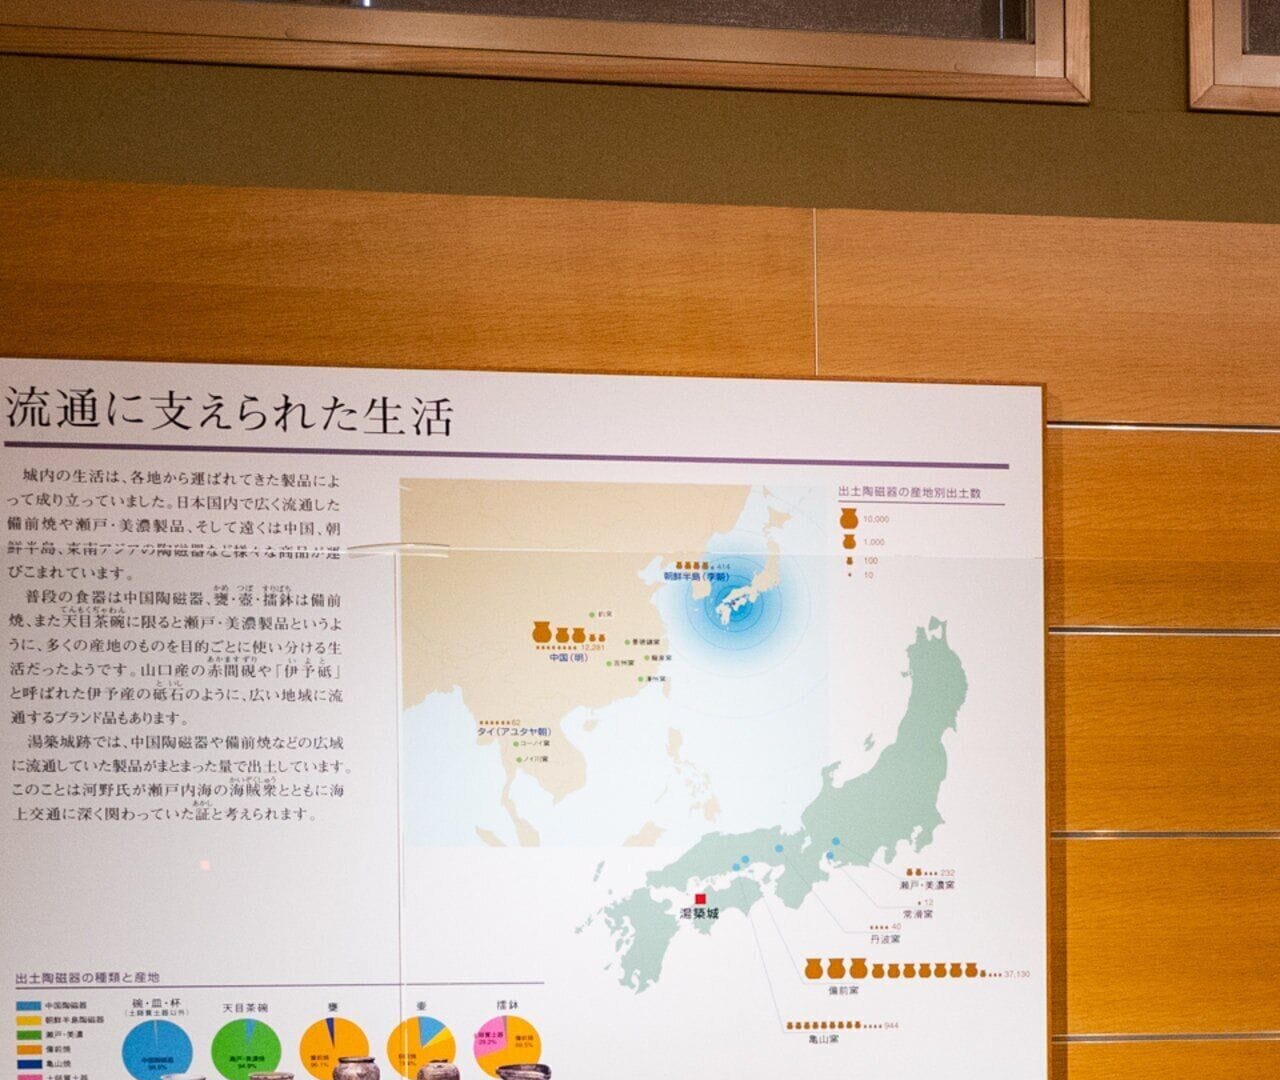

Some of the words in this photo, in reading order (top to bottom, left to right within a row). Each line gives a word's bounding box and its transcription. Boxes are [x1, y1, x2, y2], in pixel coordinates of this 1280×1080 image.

[4, 384, 455, 438] 流通に支えられた生活
[23, 467, 340, 489] 城内の生活は、各地から運ばれてきた製品によ
[837, 485, 982, 500] 出土陶磁器の産地別出土数
[7, 492, 340, 512] って成り立っていました。日本国内で広く流通した
[7, 515, 341, 536] 備前焼や瀬戸・美濃製品、そして遠くは中国、朝
[9, 565, 133, 581] びこまれています。
[9, 613, 342, 631] 焼、また天目茶碗に限ると瀬戸・美濃製品というよ
[9, 637, 342, 655] うに、多くの産地のものを目的ごとに使い分ける生
[11, 710, 188, 726] 通するブランド品もあります。
[27, 734, 344, 750] 湯築城跡では、中国陶磁器や備前焼などの広域
[12, 758, 352, 775] に流通していた製品がまとまった量で出土しています。
[12, 782, 344, 798] このことは河野氏が瀬戸内海の海賊衆とともに海
[13, 806, 316, 822] 上交通に深く関わっていた証と考えられます。
[15, 970, 161, 985] 出土陶磁器の種類と産地
[222, 1003, 269, 1013] 天目茶碗
